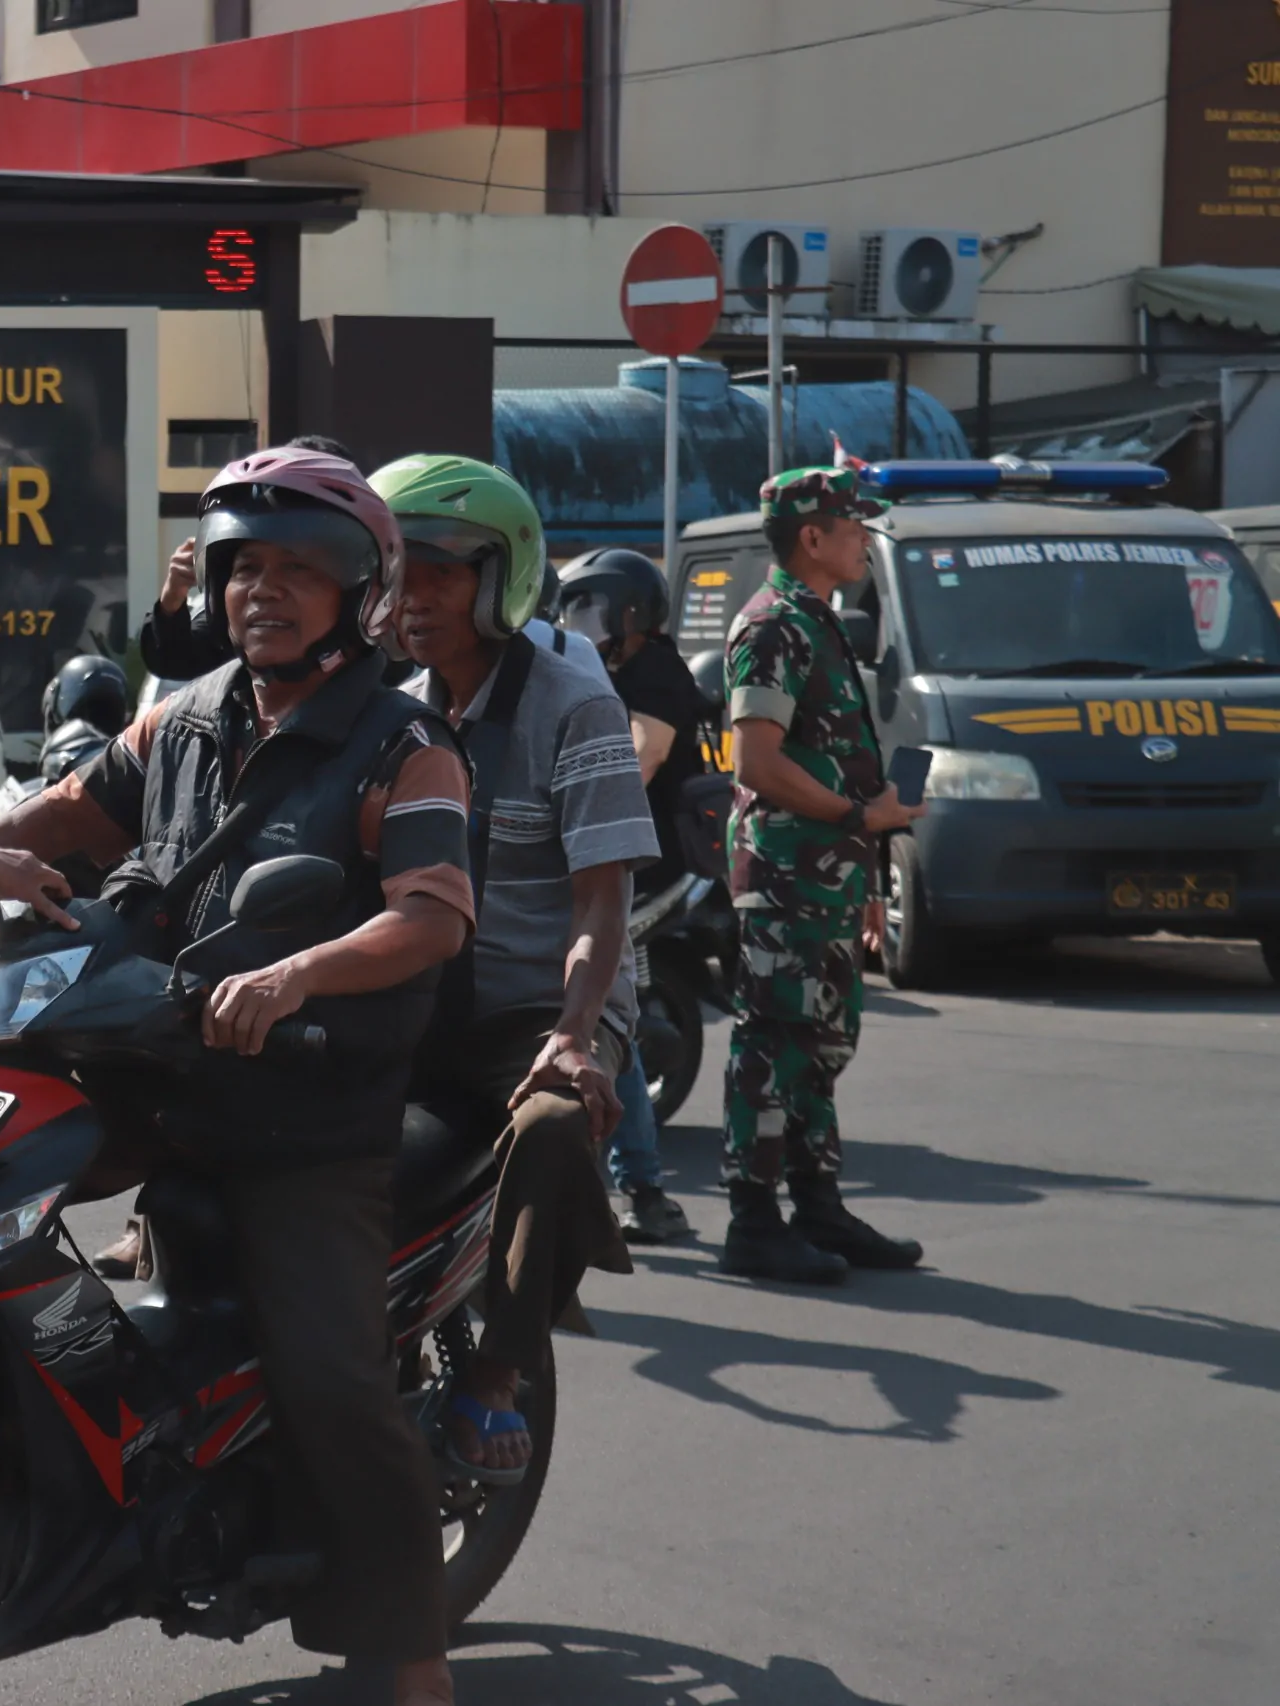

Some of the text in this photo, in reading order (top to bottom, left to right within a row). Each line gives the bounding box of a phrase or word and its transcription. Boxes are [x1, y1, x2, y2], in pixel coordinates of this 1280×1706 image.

[205, 229, 255, 292] S
[963, 545, 1042, 568] HUMAS
[1040, 542, 1121, 563] POLRES
[1085, 699, 1219, 737] POLISI
[33, 1317, 88, 1342] HONDA
